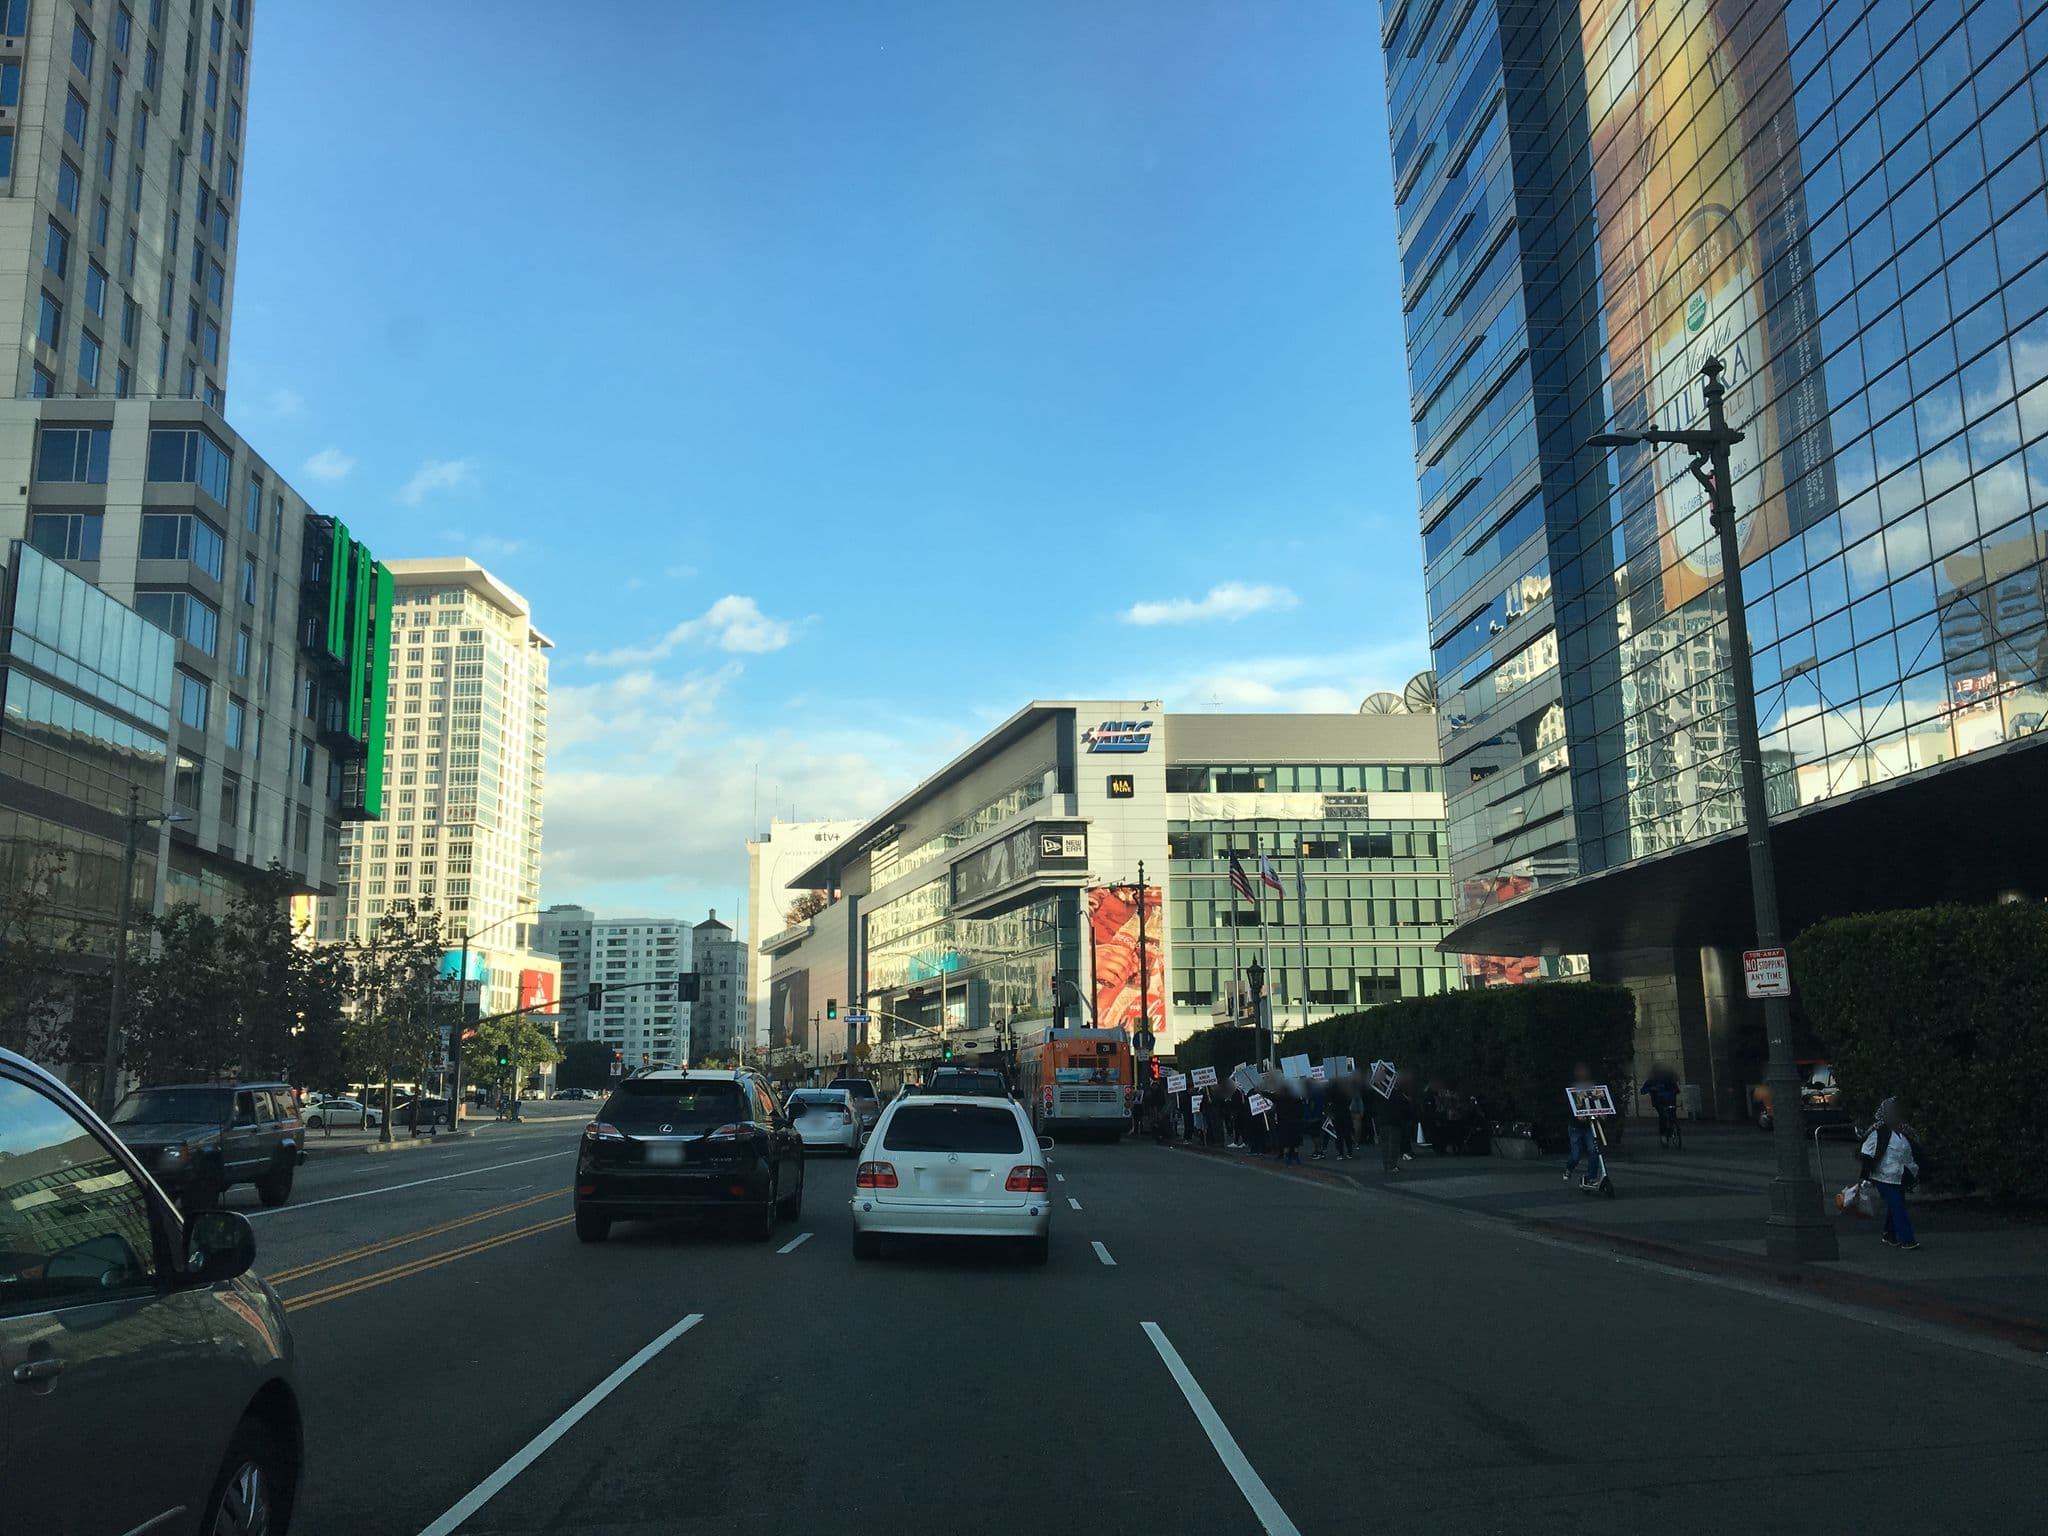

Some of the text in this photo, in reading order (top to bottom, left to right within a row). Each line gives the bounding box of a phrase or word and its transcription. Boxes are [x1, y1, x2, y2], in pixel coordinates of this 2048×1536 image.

[1664, 342, 1748, 432] ULTRA
[1086, 720, 1154, 754] AEG
[823, 833, 840, 841] tv+
[1745, 959, 1785, 971] NO STOPPING
[1766, 971, 1783, 979] TIME
